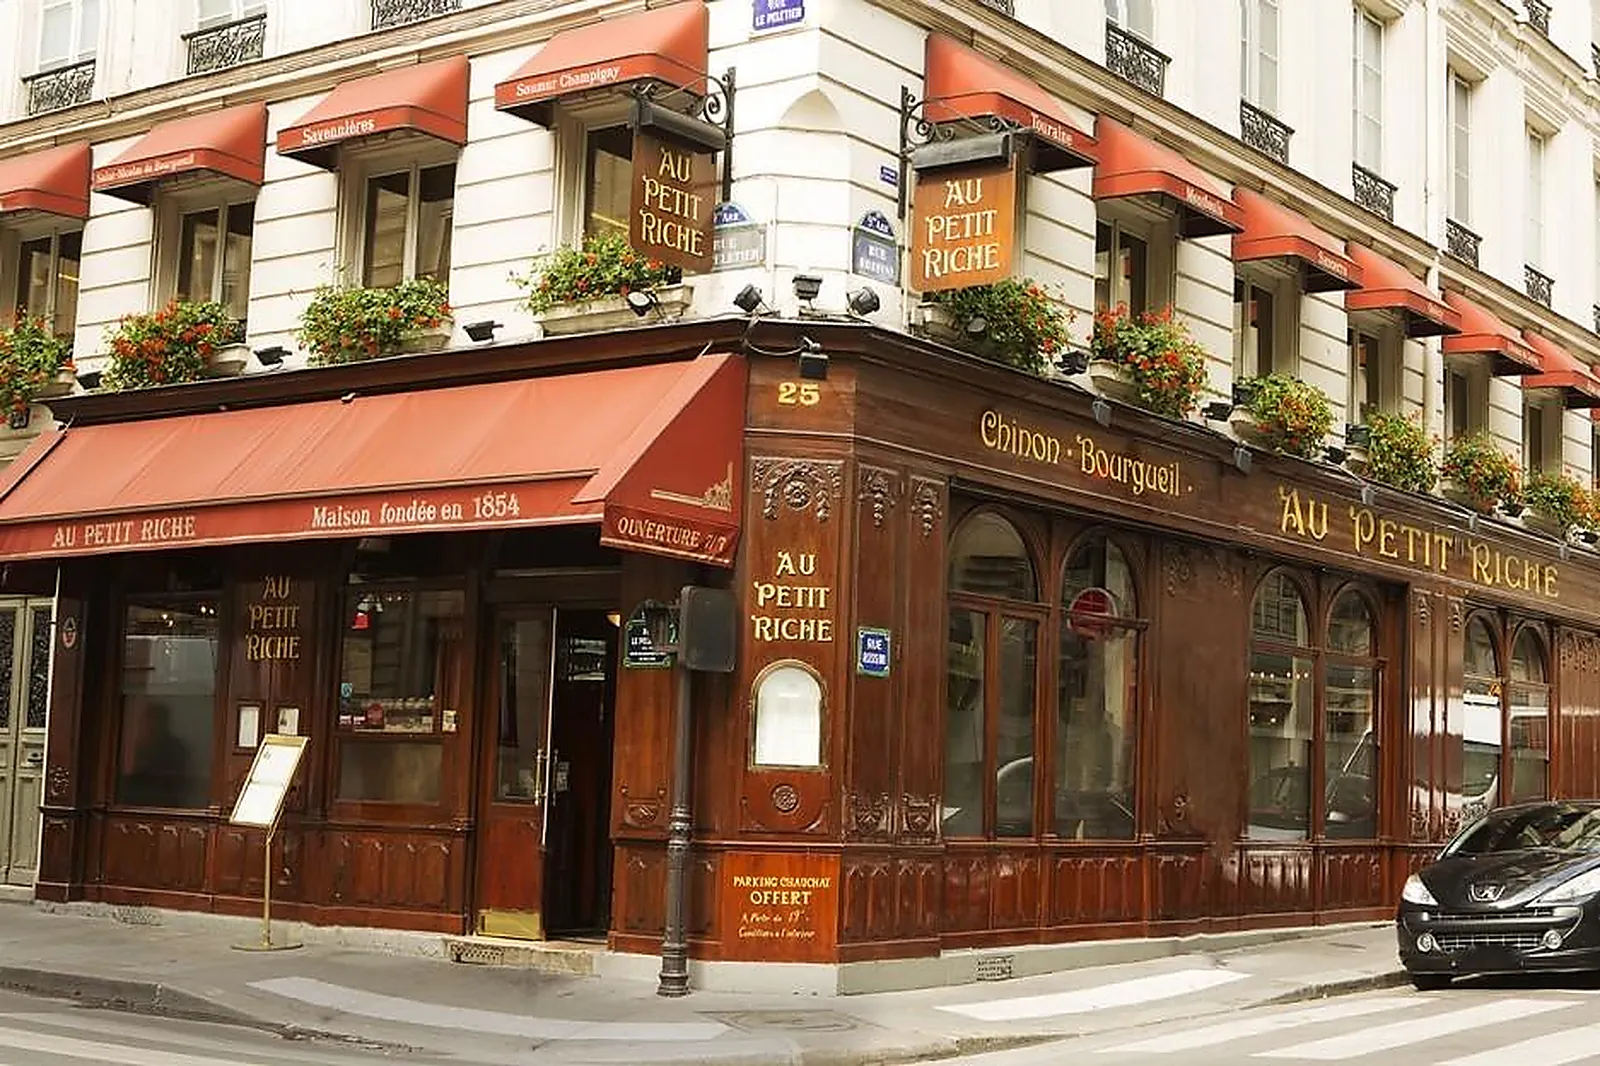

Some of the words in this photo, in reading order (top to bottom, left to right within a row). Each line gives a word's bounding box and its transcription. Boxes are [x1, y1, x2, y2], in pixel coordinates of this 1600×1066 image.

[755, 14, 766, 27] LE
[659, 146, 690, 182] AU
[642, 174, 702, 221] PETIT
[945, 178, 983, 208] AU
[640, 208, 704, 256] RICHE
[925, 209, 998, 244] PETIT
[922, 243, 1000, 278] RICHE
[778, 382, 820, 405] 25
[980, 410, 1060, 465] Chinon
[1076, 433, 1180, 497] Bourgueil
[311, 505, 370, 528] Maison
[379, 498, 436, 524] fondée
[440, 502, 463, 519] en
[472, 491, 520, 518] 1854
[52, 531, 76, 548] AU
[83, 521, 134, 545] PETIT
[140, 516, 196, 541] RICHE
[617, 517, 701, 548] OUVERTURE
[704, 533, 727, 552] 7/7
[1279, 484, 1329, 541] AU
[1349, 505, 1454, 572] PETIT
[1467, 537, 1560, 599] RICHE
[776, 551, 816, 576] AU
[262, 574, 291, 600] AU
[754, 581, 830, 608] PETIT
[248, 603, 300, 630] PETIT
[751, 615, 832, 642] RICHE
[245, 634, 301, 660] RICHE
[866, 638, 883, 651] RUE
[733, 876, 778, 888] PARKING
[750, 890, 812, 905] OFFERT
